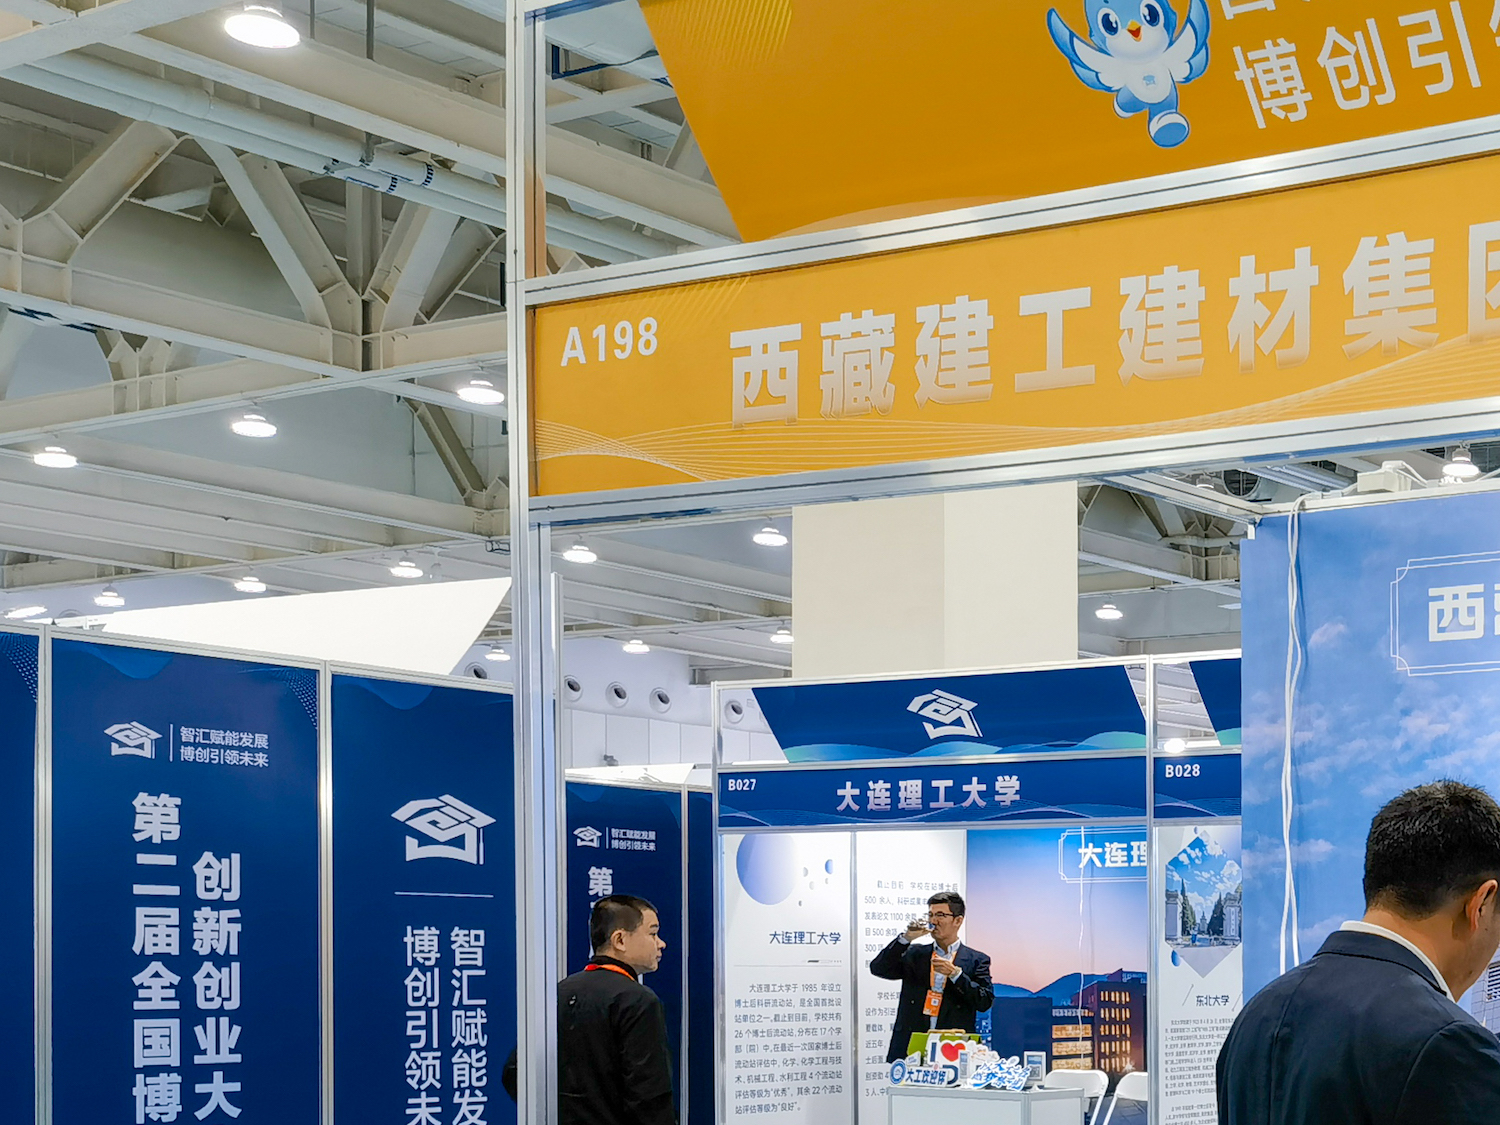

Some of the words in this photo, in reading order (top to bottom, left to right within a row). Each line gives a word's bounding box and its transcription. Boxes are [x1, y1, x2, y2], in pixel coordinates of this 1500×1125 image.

[560, 316, 659, 367] A198
[179, 726, 269, 749] 智汇赋能发展
[179, 746, 269, 769] 博创引领未来
[1165, 764, 1201, 779] B028
[727, 779, 757, 792] B027
[836, 775, 1022, 813] 大连理工大学
[768, 930, 842, 946] 大连理工大学
[1195, 995, 1230, 1007] 东北大学
